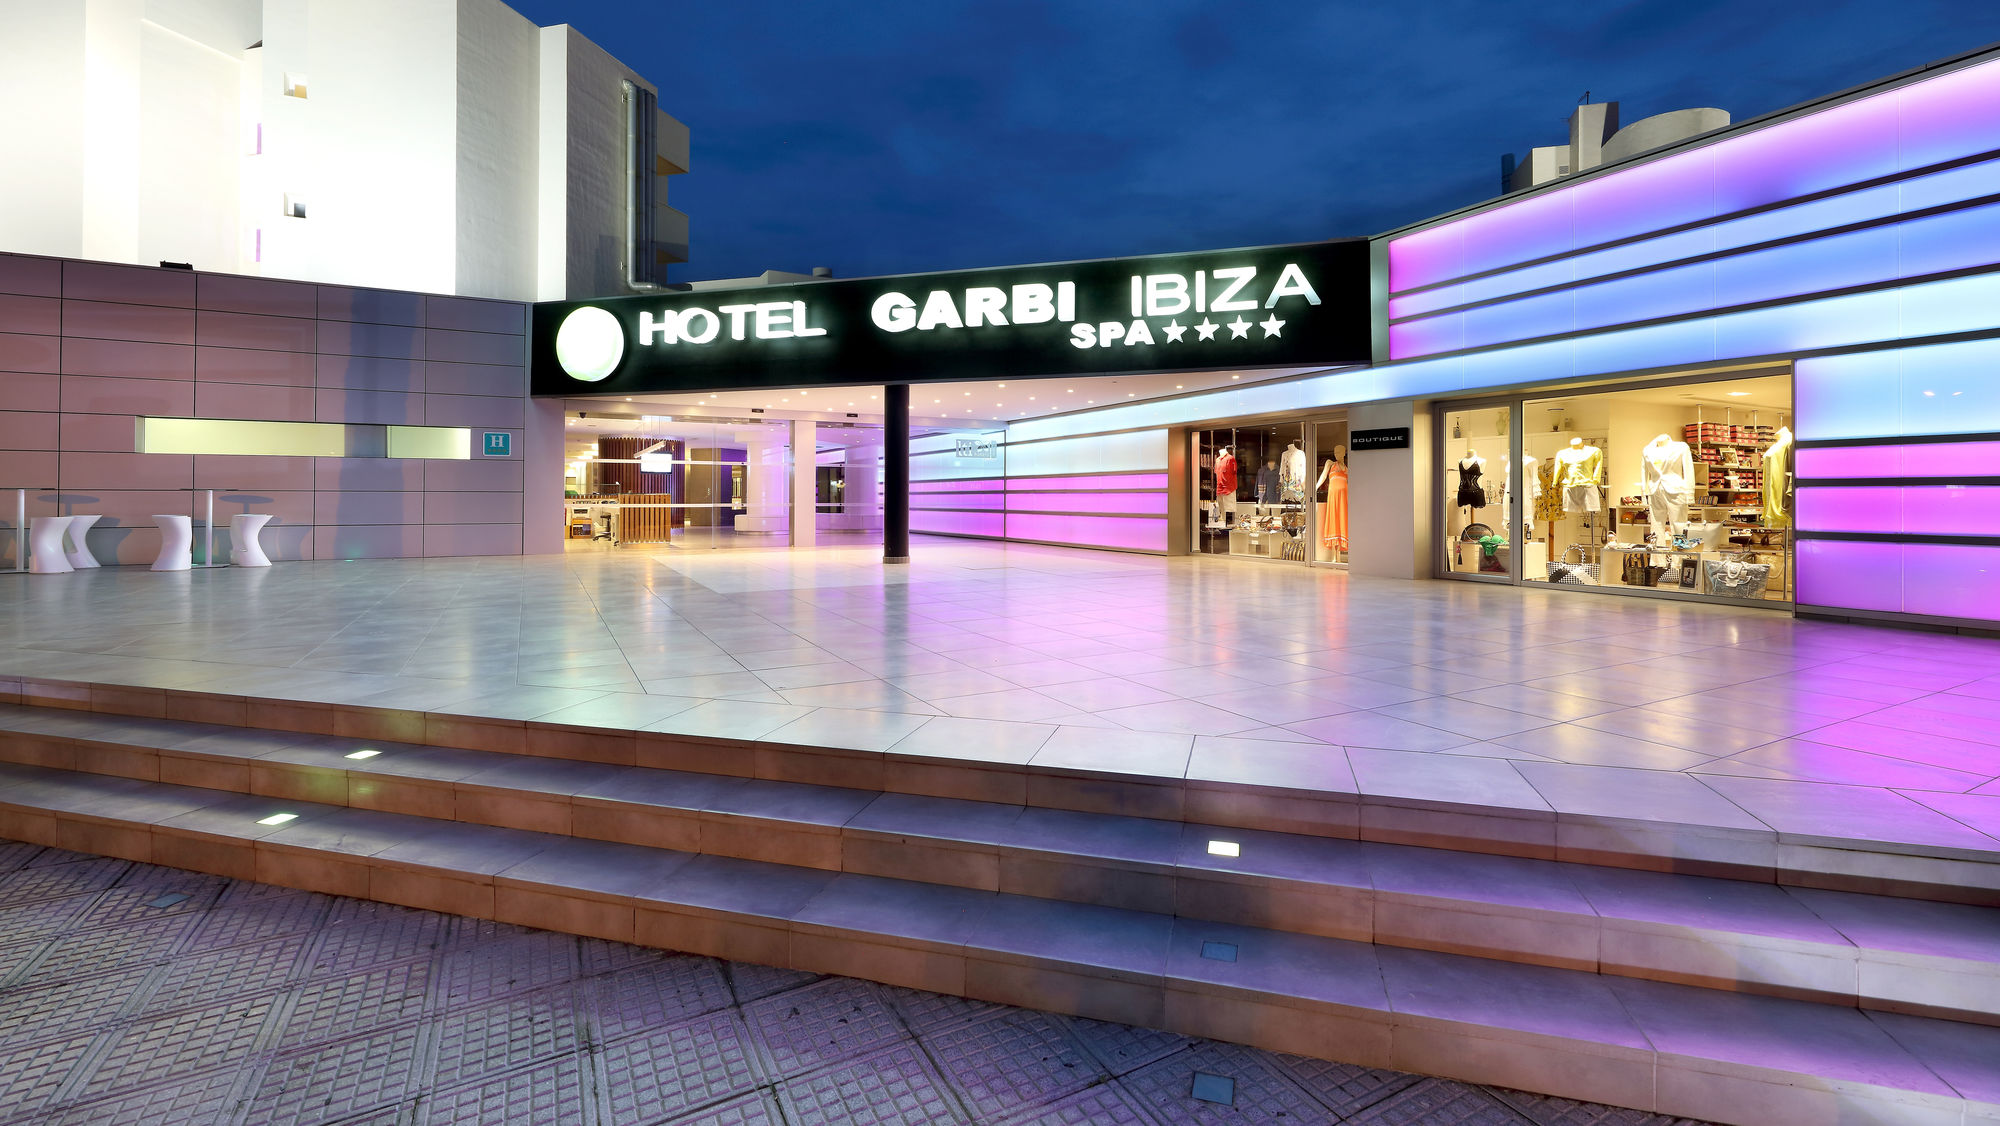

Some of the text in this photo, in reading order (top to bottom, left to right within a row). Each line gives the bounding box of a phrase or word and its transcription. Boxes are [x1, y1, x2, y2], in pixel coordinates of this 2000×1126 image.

[638, 264, 1321, 345] HOTEL GARBI IBIZA
[1070, 320, 1155, 348] SPA
[489, 435, 504, 448] H
[1352, 435, 1404, 443] BOUTIQUE
